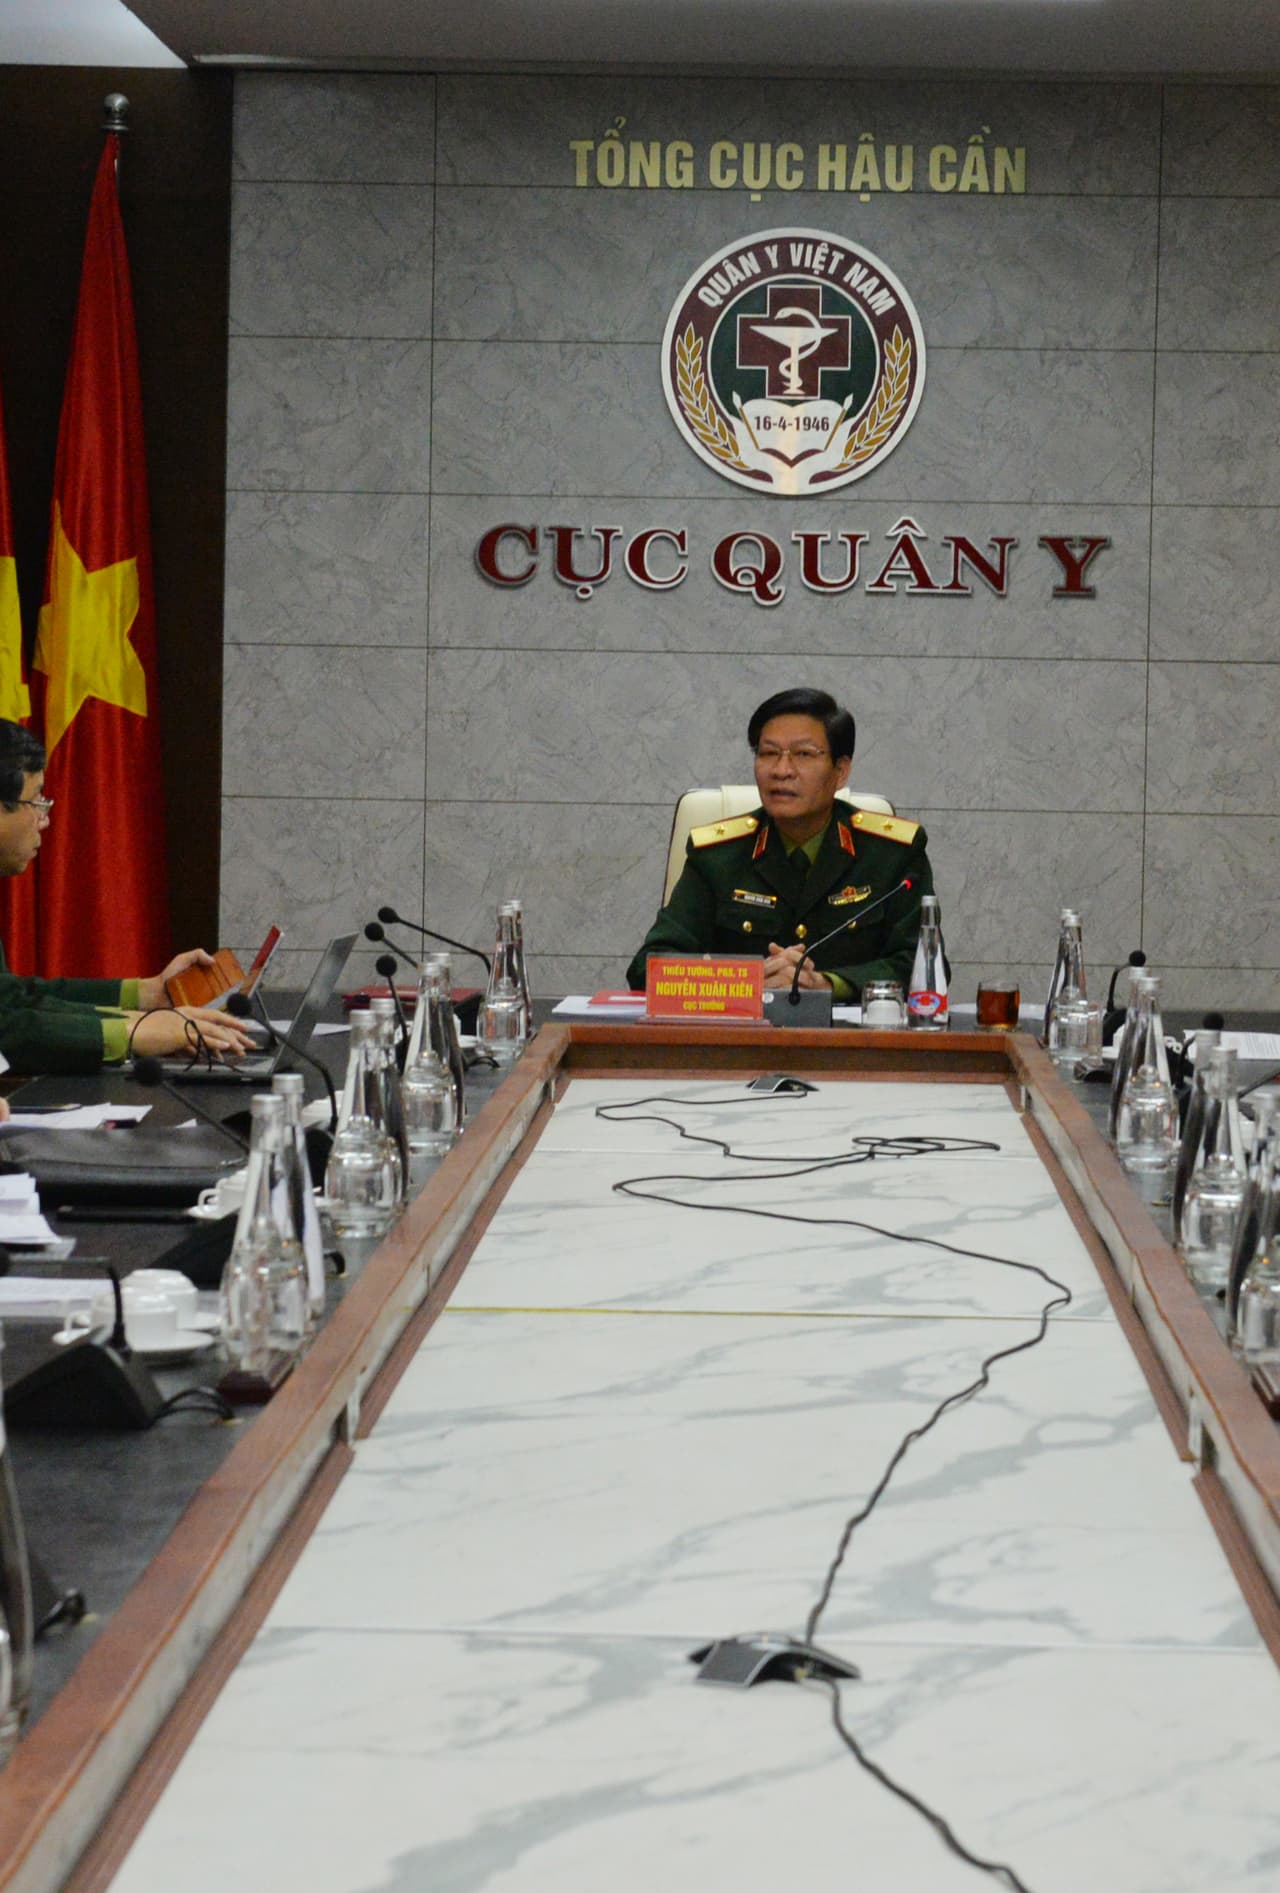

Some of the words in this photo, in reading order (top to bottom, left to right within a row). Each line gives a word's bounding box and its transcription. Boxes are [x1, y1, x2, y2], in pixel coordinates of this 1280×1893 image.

[569, 115, 694, 189] TỔNG
[708, 142, 805, 202] CỤC
[818, 133, 914, 202] HẬU
[927, 124, 1027, 194] CẦN
[698, 251, 761, 308] QUÂN
[764, 244, 779, 269] Y
[789, 242, 845, 275] VIỆT
[842, 261, 897, 316] NAM
[754, 415, 830, 432] 16-4-1946
[474, 522, 690, 600] CỤC
[709, 516, 1020, 607] QUÂN
[1038, 534, 1112, 598] Y
[699, 980, 727, 998] XUÂN
